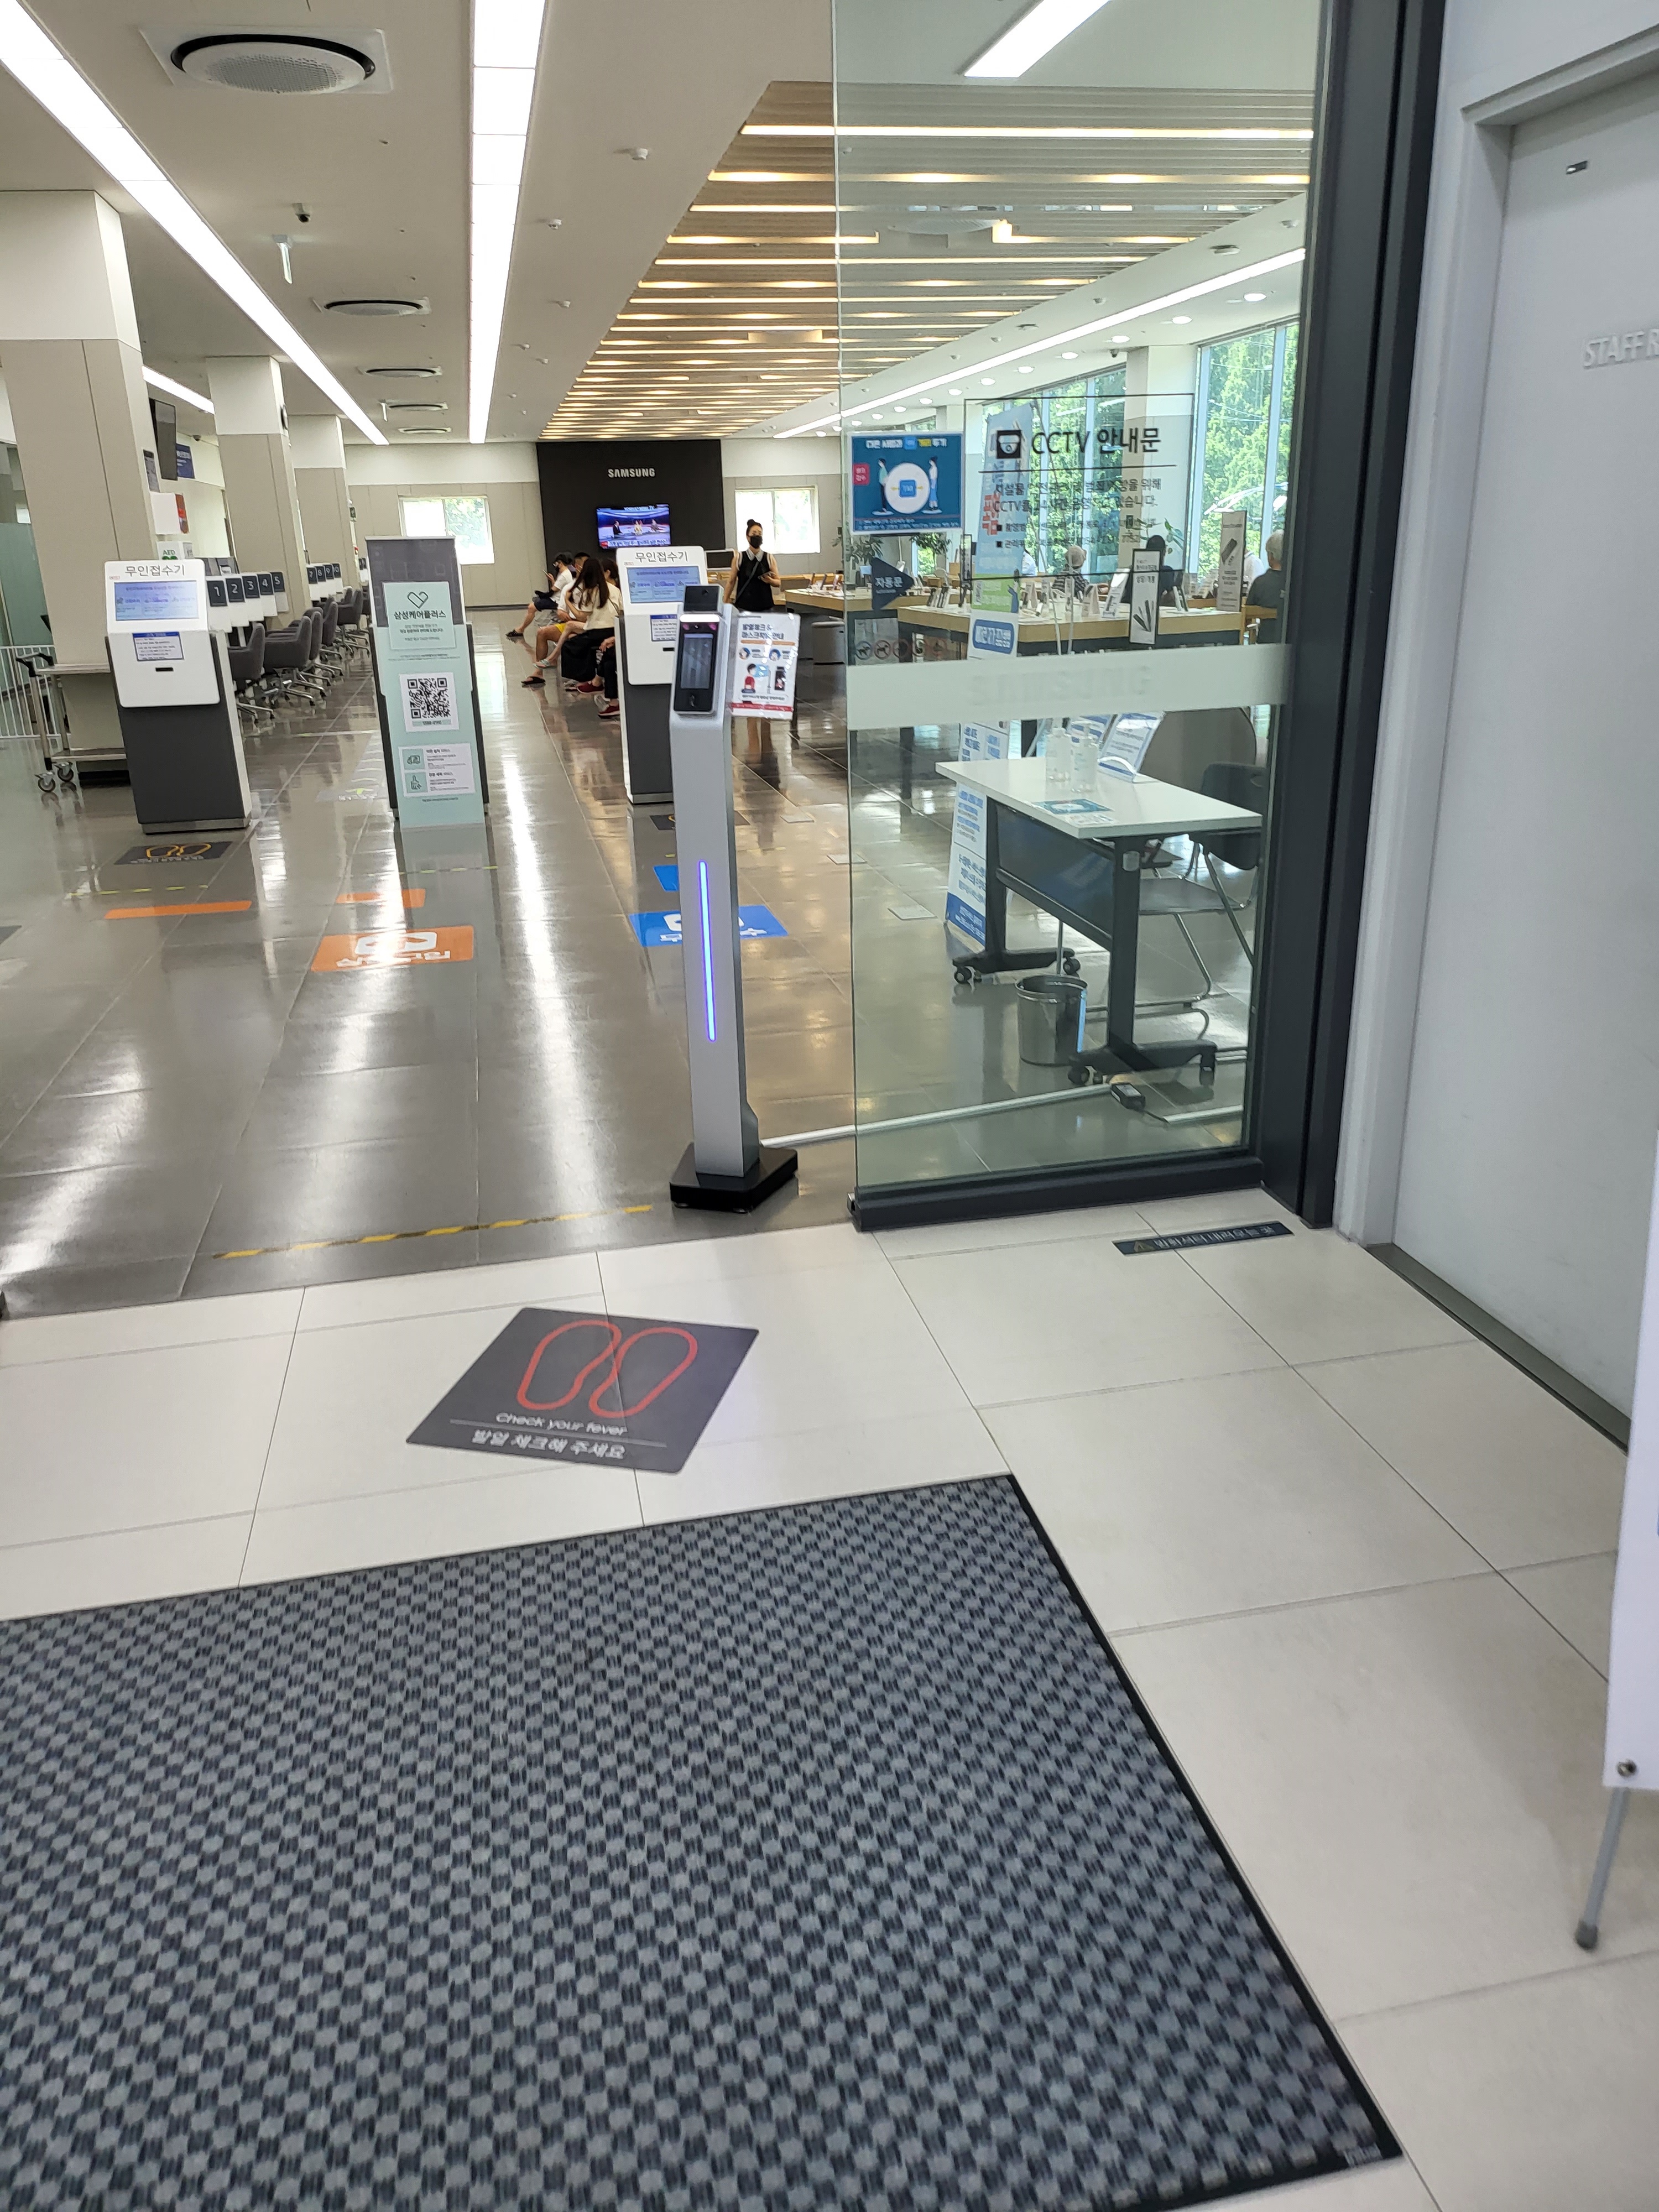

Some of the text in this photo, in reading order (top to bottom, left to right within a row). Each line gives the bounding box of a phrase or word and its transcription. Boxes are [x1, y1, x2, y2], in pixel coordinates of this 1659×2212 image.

[1583, 331, 1645, 369] STAFF
[1032, 427, 1162, 454] CCTV 안내문
[608, 468, 655, 478] SAMSUNG
[1141, 478, 1162, 491] 위해
[635, 551, 688, 562] 무인접수기
[125, 565, 185, 577] 무인접수기
[248, 581, 255, 590] 3
[262, 578, 268, 588] 4
[274, 576, 280, 585] 5
[875, 576, 902, 588] 자동문
[213, 586, 220, 596] 1
[231, 583, 238, 593] 2
[394, 609, 446, 620] 삼성케어플러스
[495, 1412, 628, 1436] Check your fever
[472, 1428, 626, 1460] 발열 체크해 주세요
